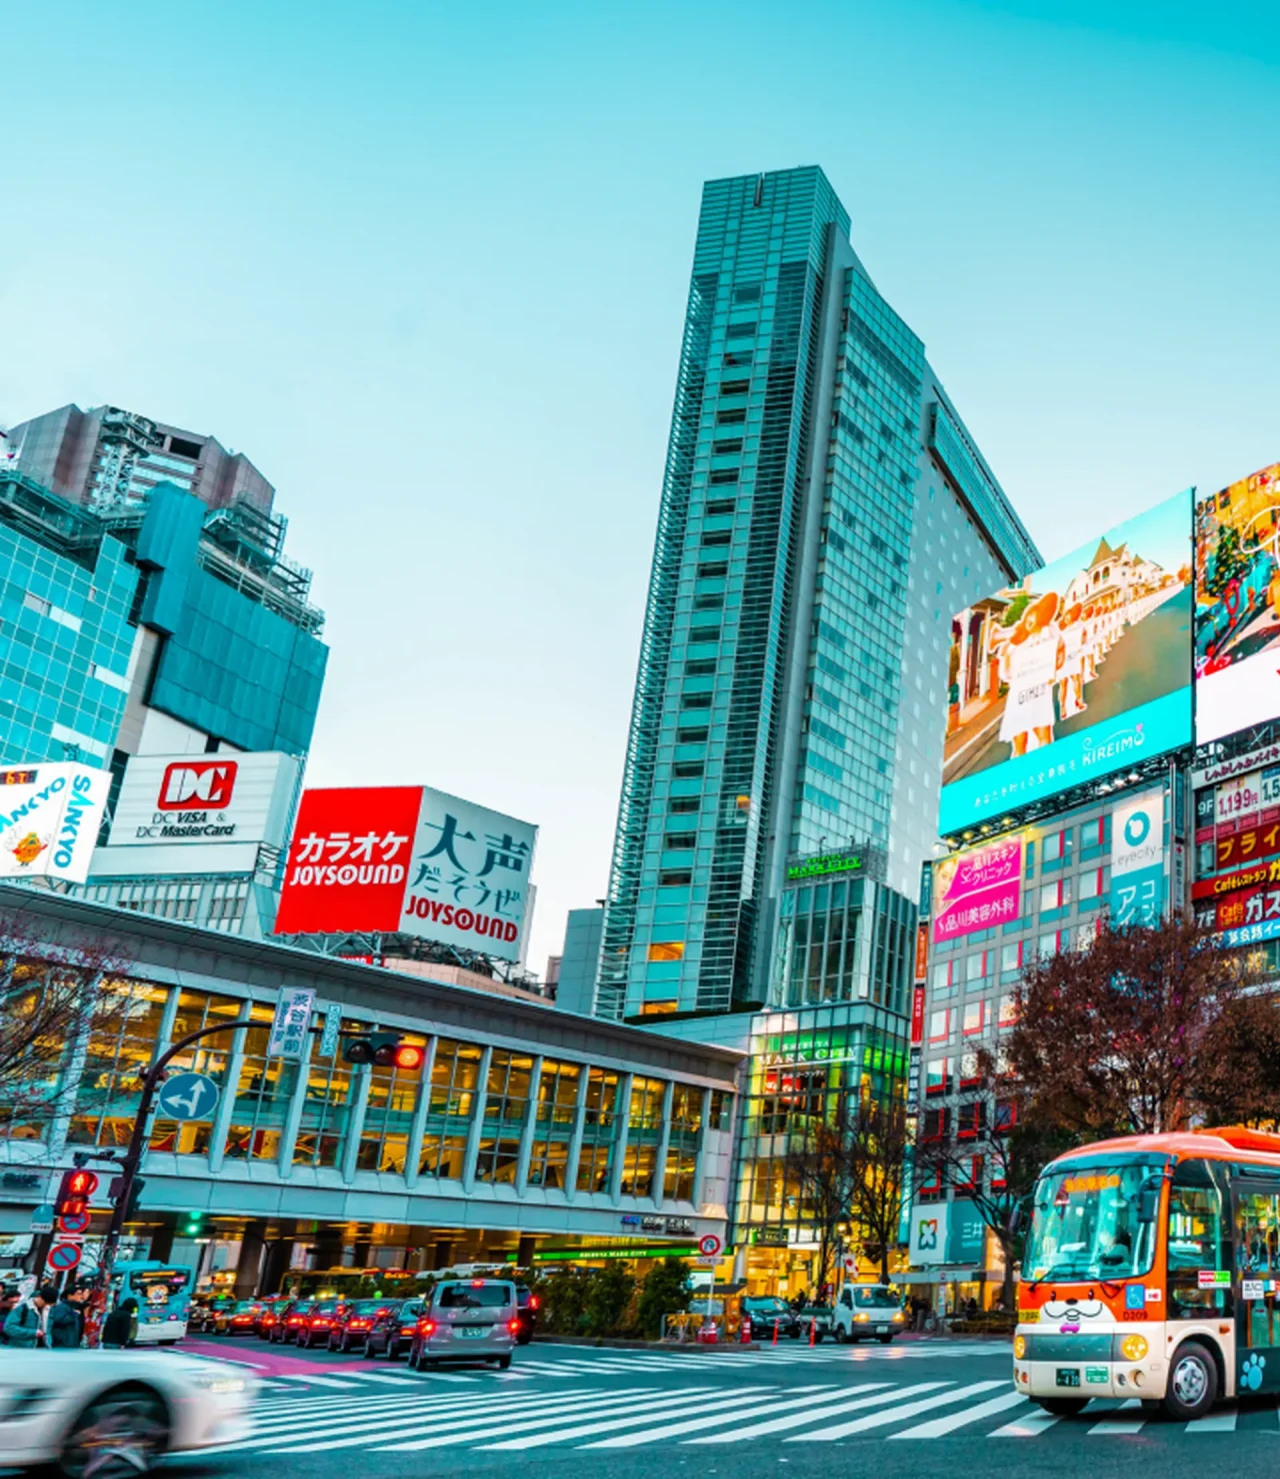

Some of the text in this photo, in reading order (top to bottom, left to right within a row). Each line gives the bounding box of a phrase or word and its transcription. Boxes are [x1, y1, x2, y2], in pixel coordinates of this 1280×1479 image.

[165, 767, 228, 802] DC
[54, 775, 95, 868] SANKYO
[177, 811, 207, 823] VISA
[1198, 799, 1213, 815] 9F
[160, 824, 236, 838] MasterCard
[296, 831, 409, 863] カラオケ
[417, 813, 531, 877] 大声
[289, 864, 405, 886] JOYSOUND
[405, 894, 519, 943] JOYSOUND
